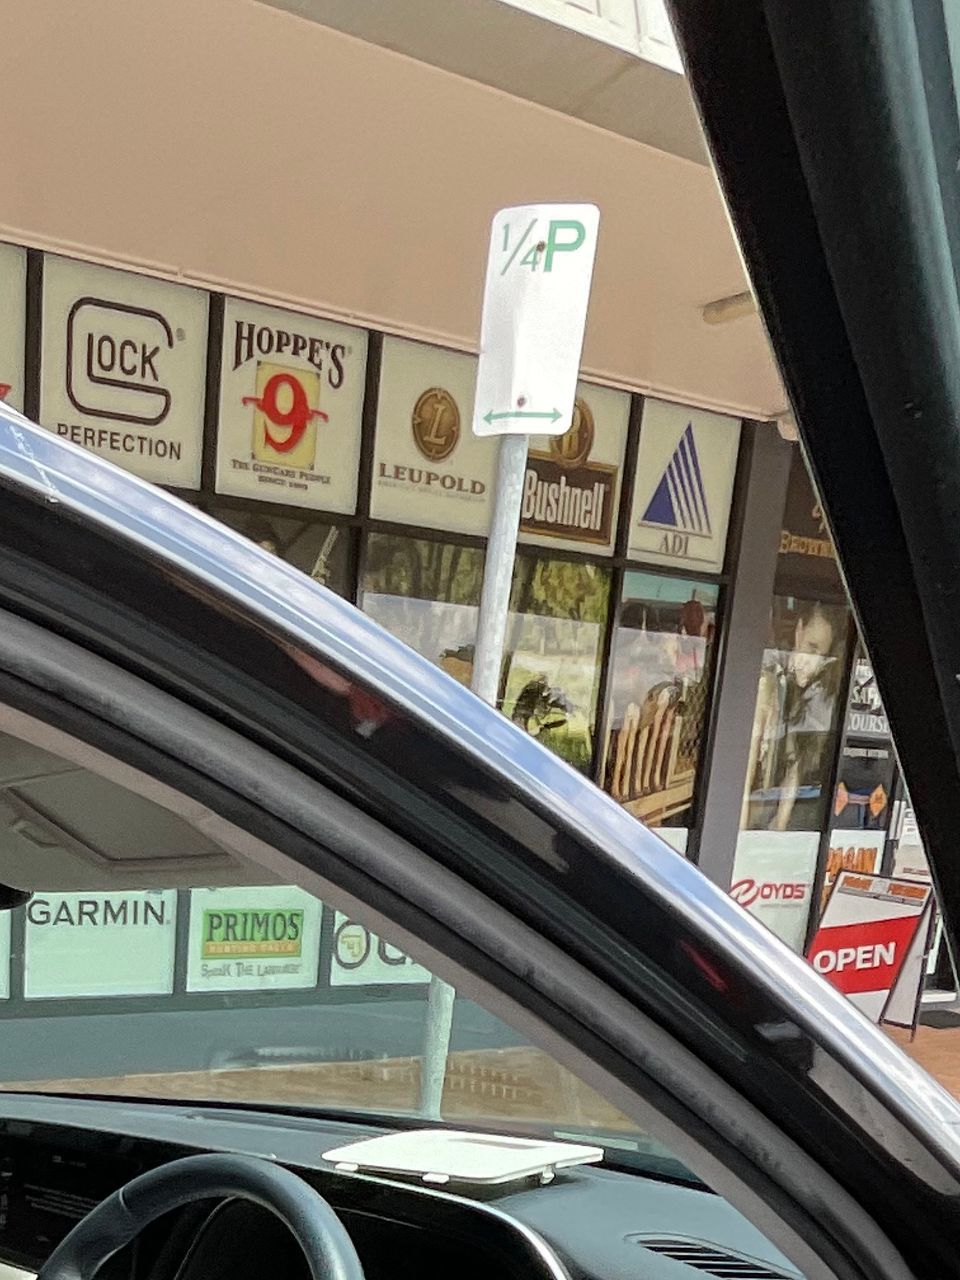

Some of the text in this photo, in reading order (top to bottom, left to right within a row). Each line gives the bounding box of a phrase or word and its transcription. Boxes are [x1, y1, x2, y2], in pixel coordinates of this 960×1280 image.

[233, 320, 346, 390] HOPPE'S
[242, 373, 329, 453] 9
[56, 422, 182, 461] PERFECTION
[378, 462, 486, 495] LEUPOLD
[521, 468, 605, 532] Bushnell
[26, 899, 166, 925] GARMIN
[206, 911, 303, 942] PRIMOS
[812, 941, 897, 975] OPEN
